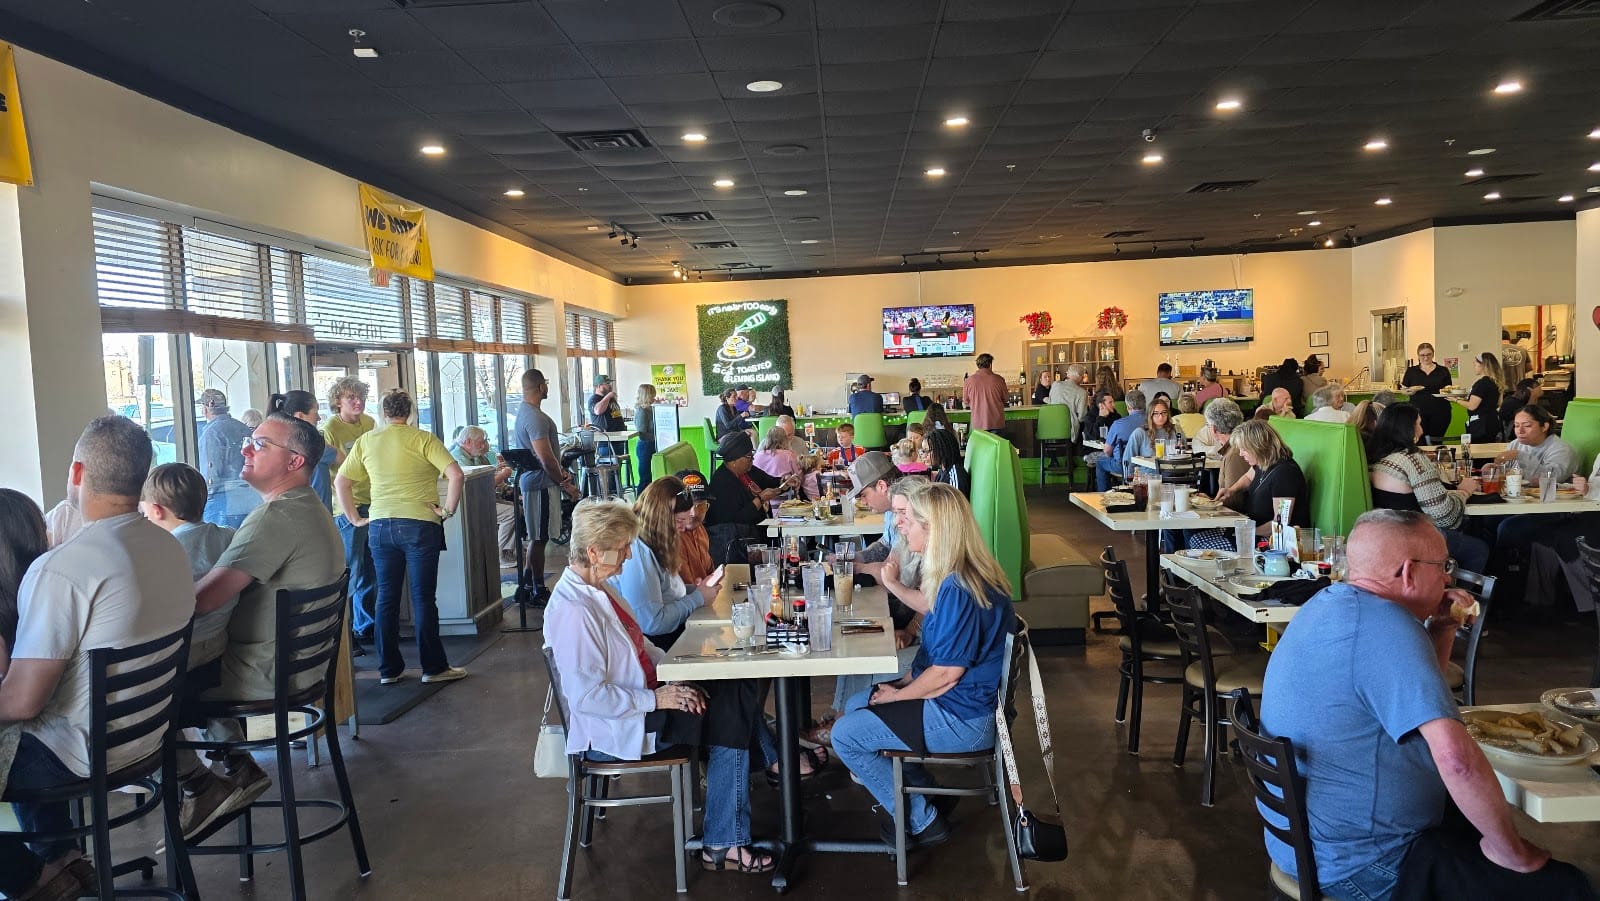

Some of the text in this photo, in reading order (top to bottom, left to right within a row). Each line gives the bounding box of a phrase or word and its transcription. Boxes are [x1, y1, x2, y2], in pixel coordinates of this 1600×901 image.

[365, 205, 387, 231] WE
[742, 302, 759, 311] TOO
[736, 360, 772, 374] TOASTED
[755, 373, 780, 382] ISLAND
